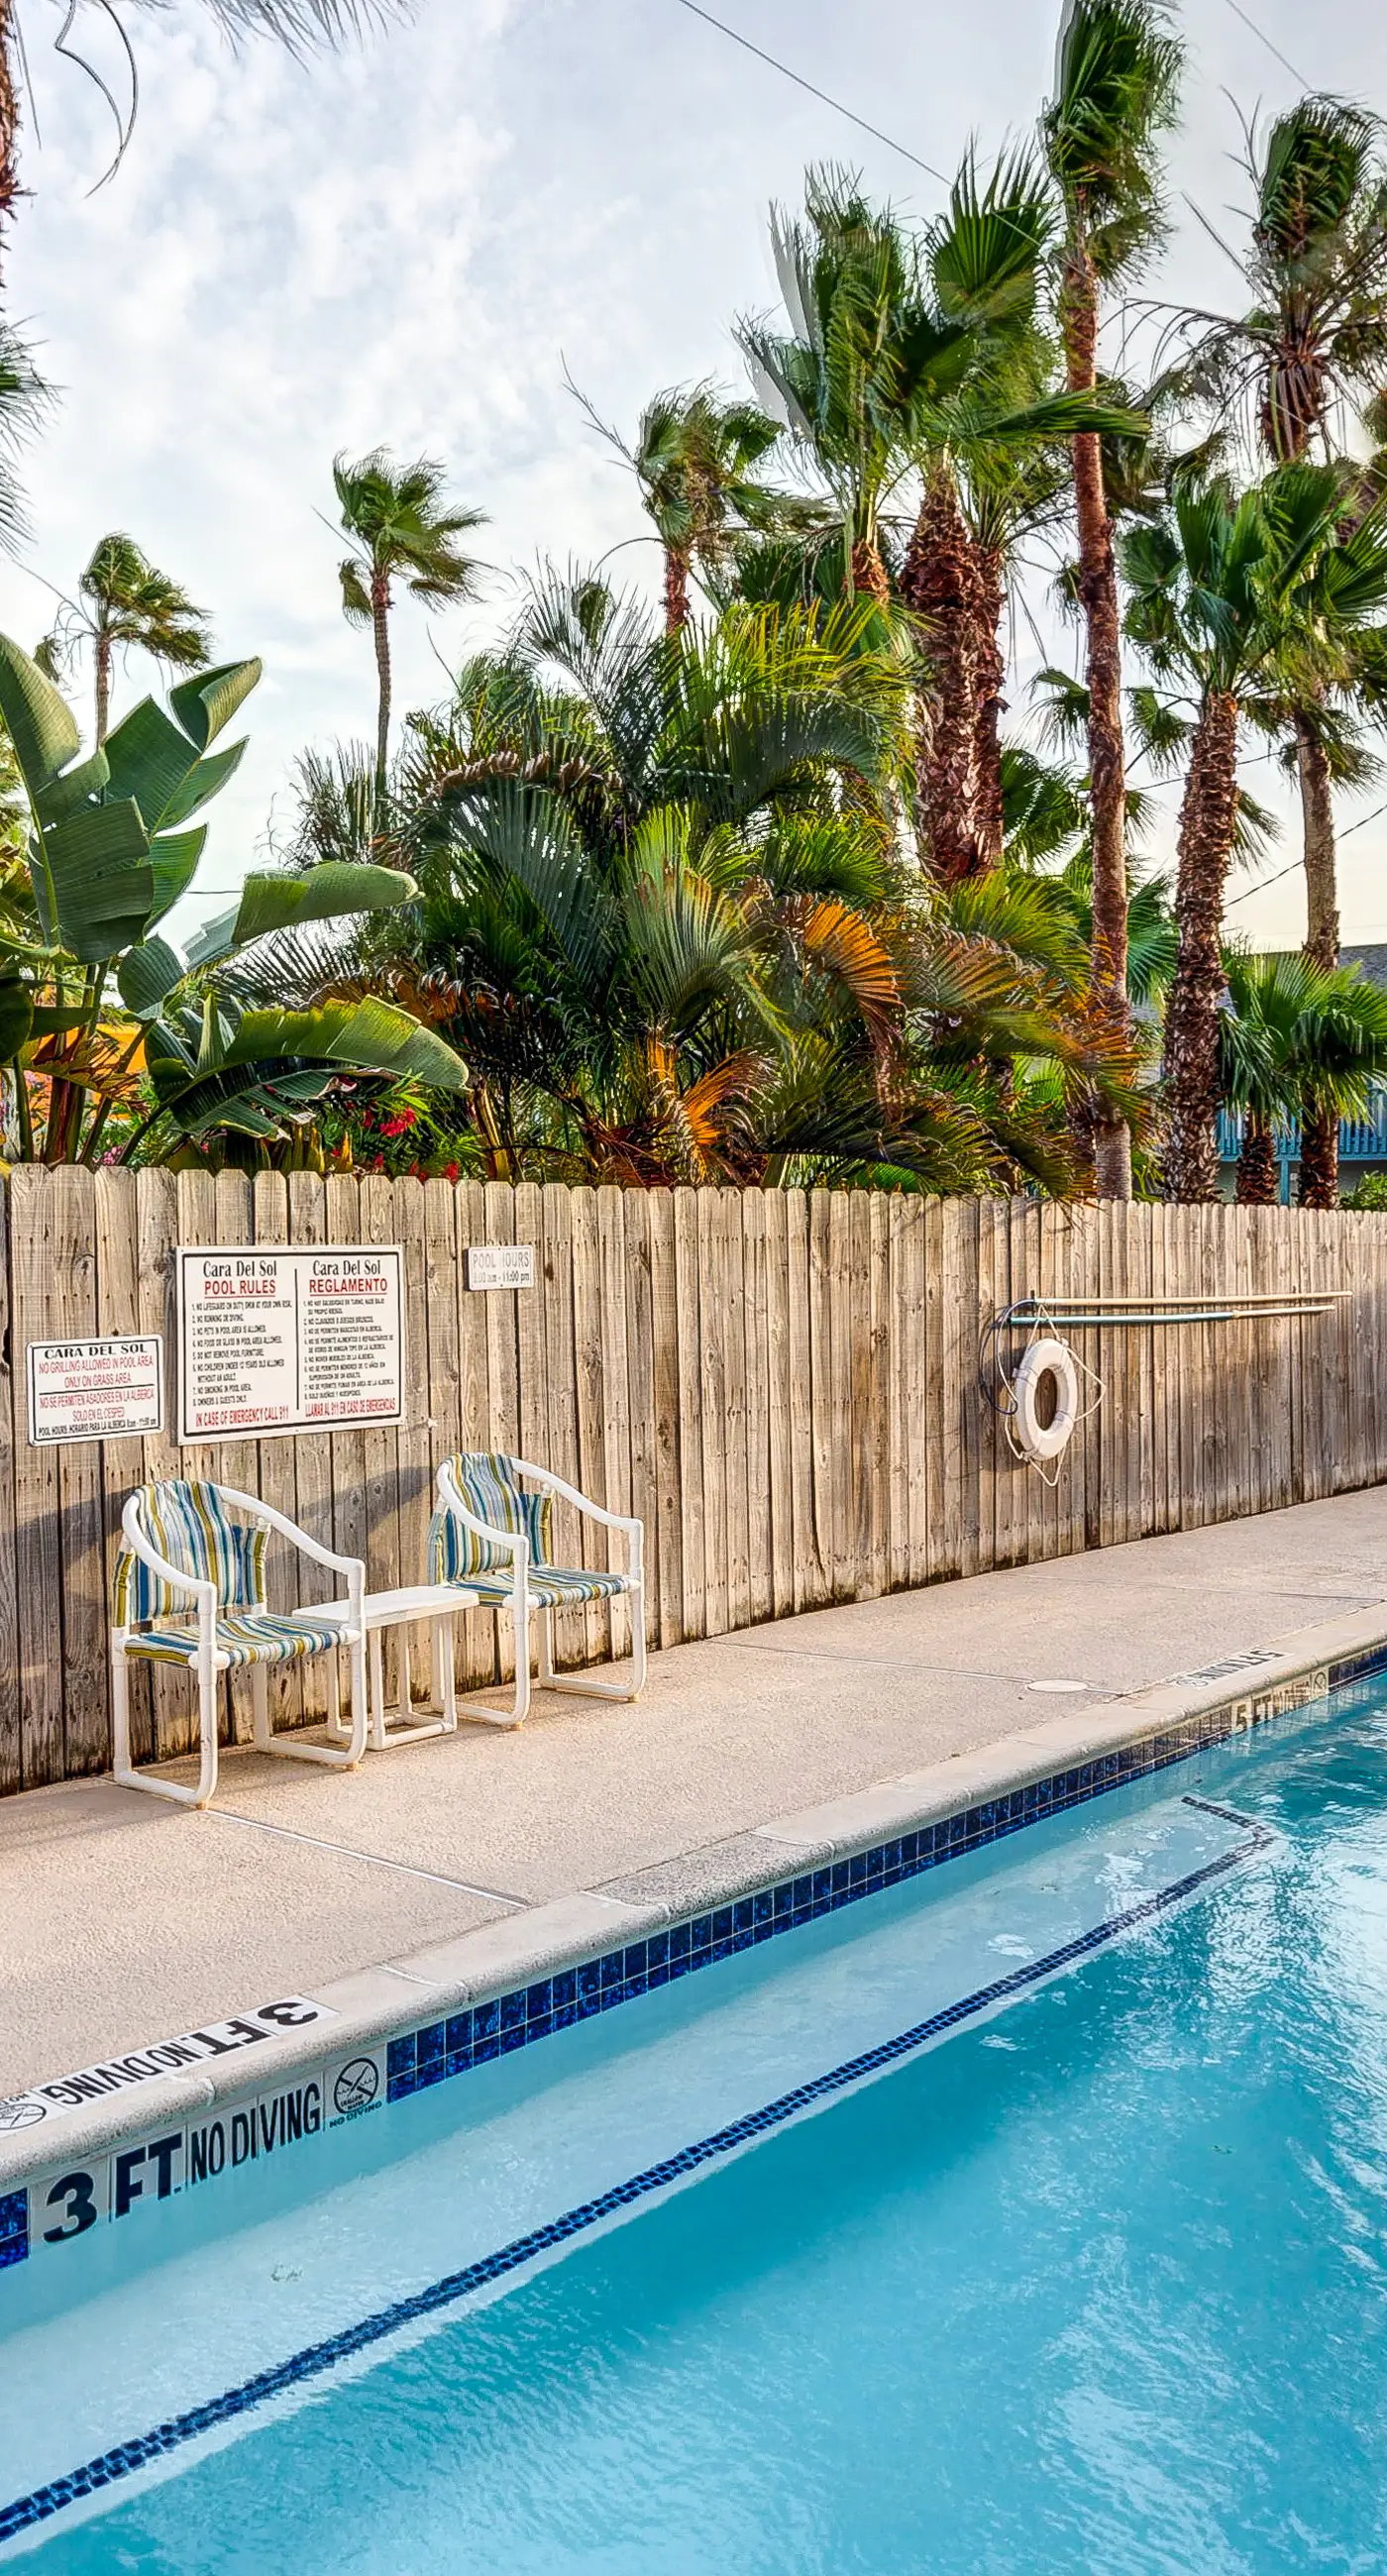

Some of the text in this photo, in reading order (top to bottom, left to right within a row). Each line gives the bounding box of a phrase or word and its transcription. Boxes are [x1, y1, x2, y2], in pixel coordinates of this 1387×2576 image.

[203, 1260, 277, 1277] Cara Del Sol
[312, 1259, 380, 1276] Cara Del Sol
[473, 1252, 496, 1269] POOL
[204, 1279, 276, 1295] POOL RULES
[309, 1278, 388, 1293] REGLAMENTO
[520, 1273, 530, 1285] pm
[44, 1343, 148, 1359] CARA DEL SOL
[39, 1355, 154, 1374] NO GRILLING ALLOWED IN POOL AREA
[64, 1372, 132, 1388] ONLY ON GRASS AREA
[40, 1397, 50, 1408] NO
[50, 1397, 57, 1407] SE
[57, 1394, 85, 1407] PERMITEN
[115, 1391, 123, 1402] EN
[123, 1391, 130, 1401] LA
[131, 1389, 155, 1401] ALBERCA
[195, 1413, 202, 1427] IN
[204, 1412, 219, 1427] CASE
[220, 1411, 228, 1425] OF
[265, 1407, 277, 1422] CALL
[279, 1406, 289, 1421] 911
[257, 2001, 319, 2026] 3
[151, 2042, 203, 2068] NO
[41, 2055, 162, 2105] DIVING
[330, 2116, 345, 2128] NO
[43, 2172, 98, 2243] 3
[191, 2120, 226, 2185] NO
[231, 2082, 321, 2169] DIVING
